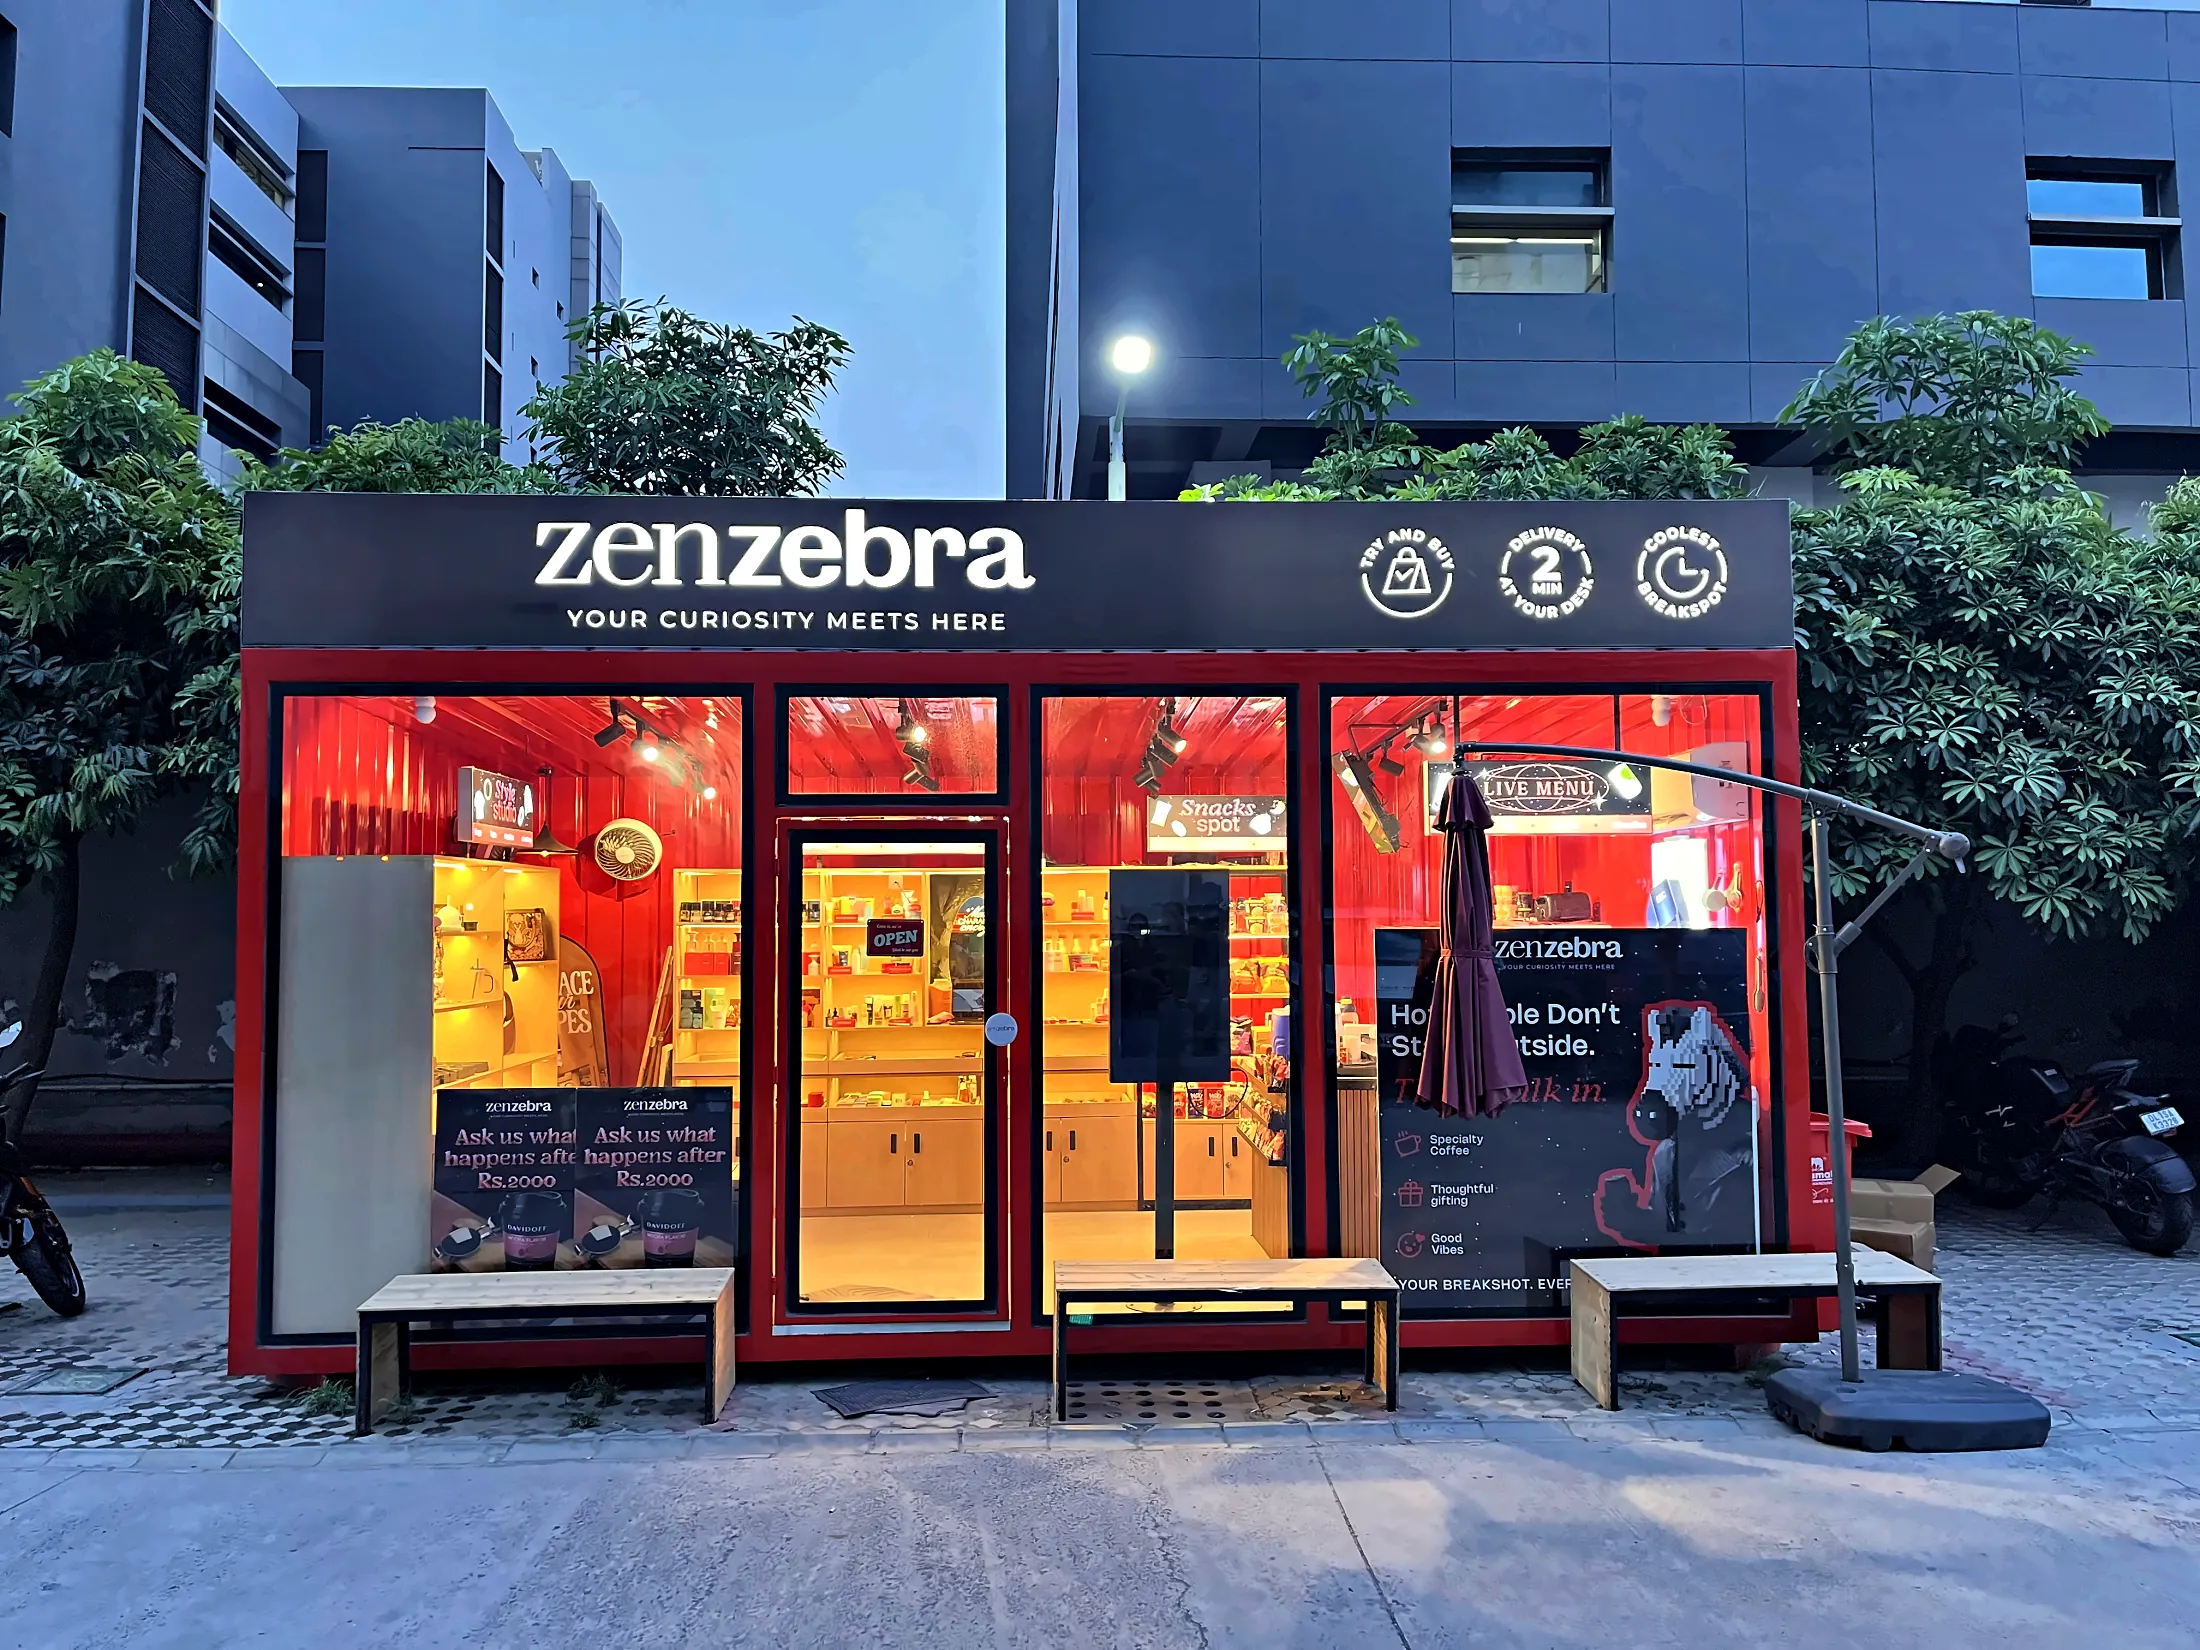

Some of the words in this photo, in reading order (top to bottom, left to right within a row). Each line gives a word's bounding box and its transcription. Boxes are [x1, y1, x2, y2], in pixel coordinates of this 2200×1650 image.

[535, 508, 1036, 589] zenzebra
[1360, 537, 1385, 568] TRY
[1388, 528, 1426, 544] AND
[1427, 537, 1455, 569] BUY
[1509, 527, 1586, 552] DELIVERY
[1644, 526, 1720, 552] COOLEST
[1531, 546, 1562, 582] 2
[1499, 577, 1518, 596] AT
[1514, 594, 1559, 619] YOUR
[1560, 576, 1595, 615] DESK
[1532, 582, 1563, 595] MIN
[1637, 581, 1727, 618] BREAKSPOT
[567, 608, 647, 629] YOUR
[659, 609, 815, 631] CURIOSITY
[828, 611, 919, 631] MEETS
[932, 612, 1007, 631] HERE
[495, 779, 516, 803] Style
[1484, 780, 1529, 796] LIVE
[1536, 780, 1595, 796] MENU
[493, 801, 517, 824] studio
[1178, 798, 1257, 817] Snacks
[1196, 816, 1241, 836] spot
[873, 930, 918, 948] OPEN
[1495, 936, 1624, 959] zenzebra
[559, 970, 594, 996] ACE
[558, 1008, 592, 1034] PES
[1391, 1004, 1430, 1025] Ho
[1548, 1003, 1621, 1025] Don't
[486, 1100, 552, 1112] zenzebra
[624, 1098, 688, 1111] zenzebra
[455, 1127, 495, 1146] Ask
[500, 1131, 523, 1145] us
[594, 1125, 632, 1144] Ask
[637, 1130, 661, 1143] us
[666, 1125, 716, 1143] what
[1430, 1134, 1484, 1146] Specialty
[444, 1150, 536, 1170] happens
[540, 1148, 576, 1165] afte
[583, 1148, 672, 1167] happens
[677, 1146, 726, 1163] after
[1430, 1145, 1470, 1156] Coffee
[478, 1172, 557, 1189] Rs.2000
[616, 1170, 694, 1187] Rs.2000
[1430, 1183, 1494, 1196] Thoughtful
[1430, 1195, 1469, 1208] gifting
[507, 1224, 548, 1233] DAVIDOFF
[646, 1221, 686, 1230] DAVIDOFF
[1431, 1233, 1462, 1243] Good
[1431, 1244, 1464, 1255] Vibes
[1398, 1279, 1438, 1291] YOUR
[1443, 1278, 1533, 1291] BREAKSHOT.
